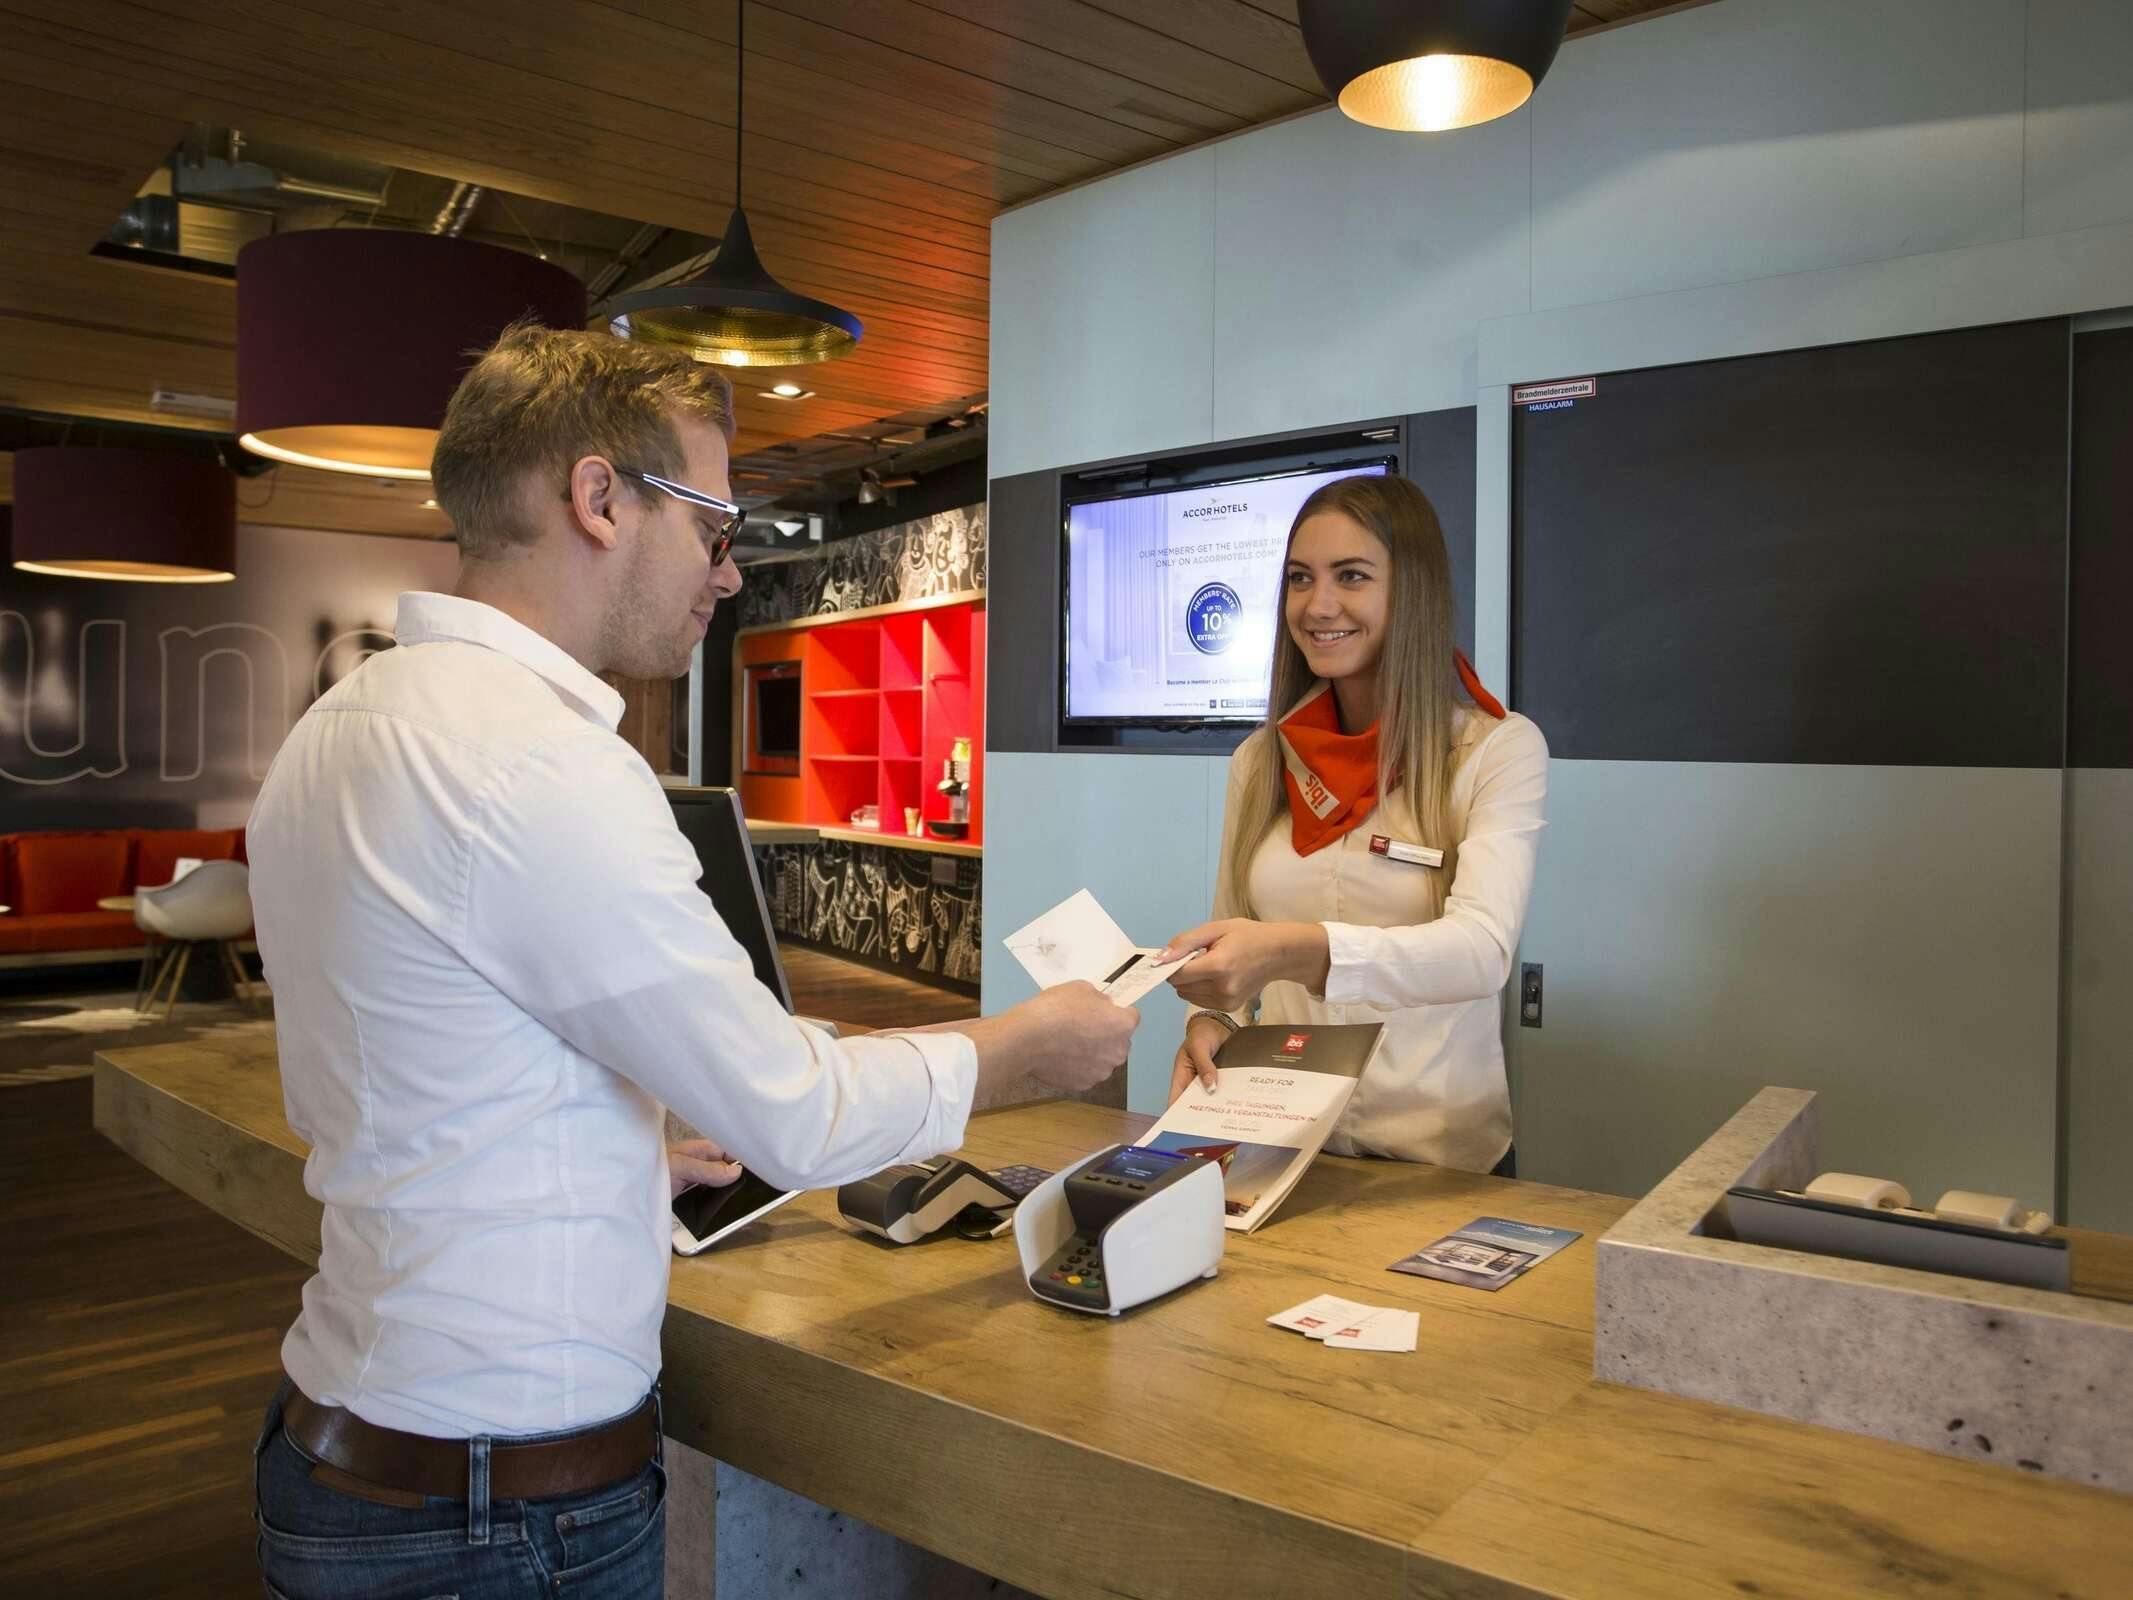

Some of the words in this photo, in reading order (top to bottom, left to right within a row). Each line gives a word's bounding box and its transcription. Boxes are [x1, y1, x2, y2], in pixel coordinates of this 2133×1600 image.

[1517, 384, 1589, 400] Brandmelderzentrale
[1529, 400, 1574, 412] HAUSALARM
[1139, 550, 1155, 559] OUR
[1157, 546, 1195, 556] MEMBERS
[1197, 543, 1212, 553] GET
[1216, 542, 1231, 551] THE
[1233, 538, 1269, 549] LOWEST
[1156, 558, 1175, 568] ONLY
[1178, 557, 1191, 566] ON
[1250, 1076, 1275, 1085] READY
[1277, 1079, 1295, 1087] FOR
